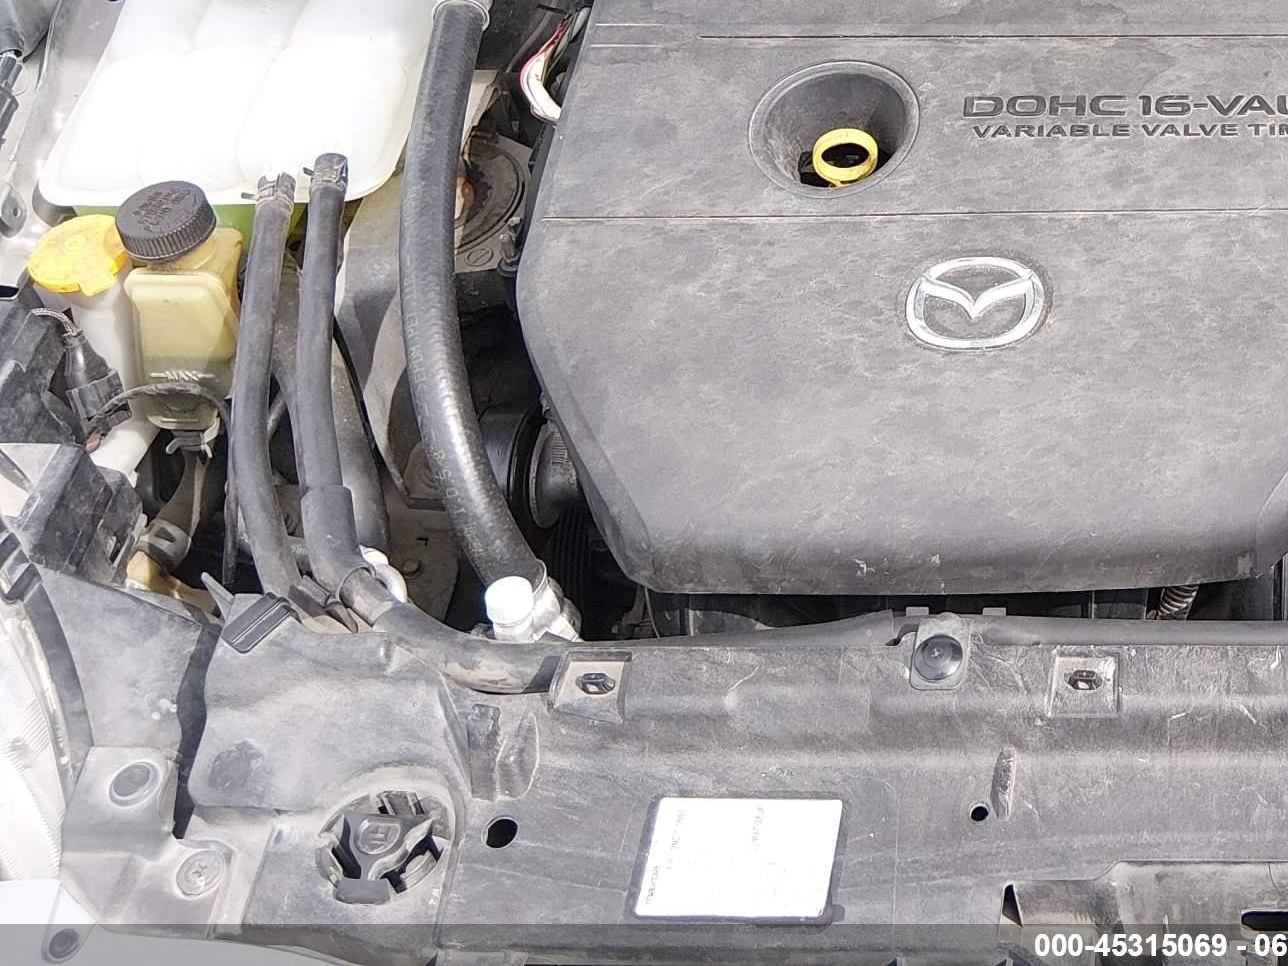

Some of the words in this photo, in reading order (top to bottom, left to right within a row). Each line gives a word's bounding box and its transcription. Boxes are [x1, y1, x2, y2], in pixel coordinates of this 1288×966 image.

[962, 94, 1127, 118] DOHC
[972, 123, 1130, 139] VARIABLE
[1141, 123, 1239, 138] VALVE
